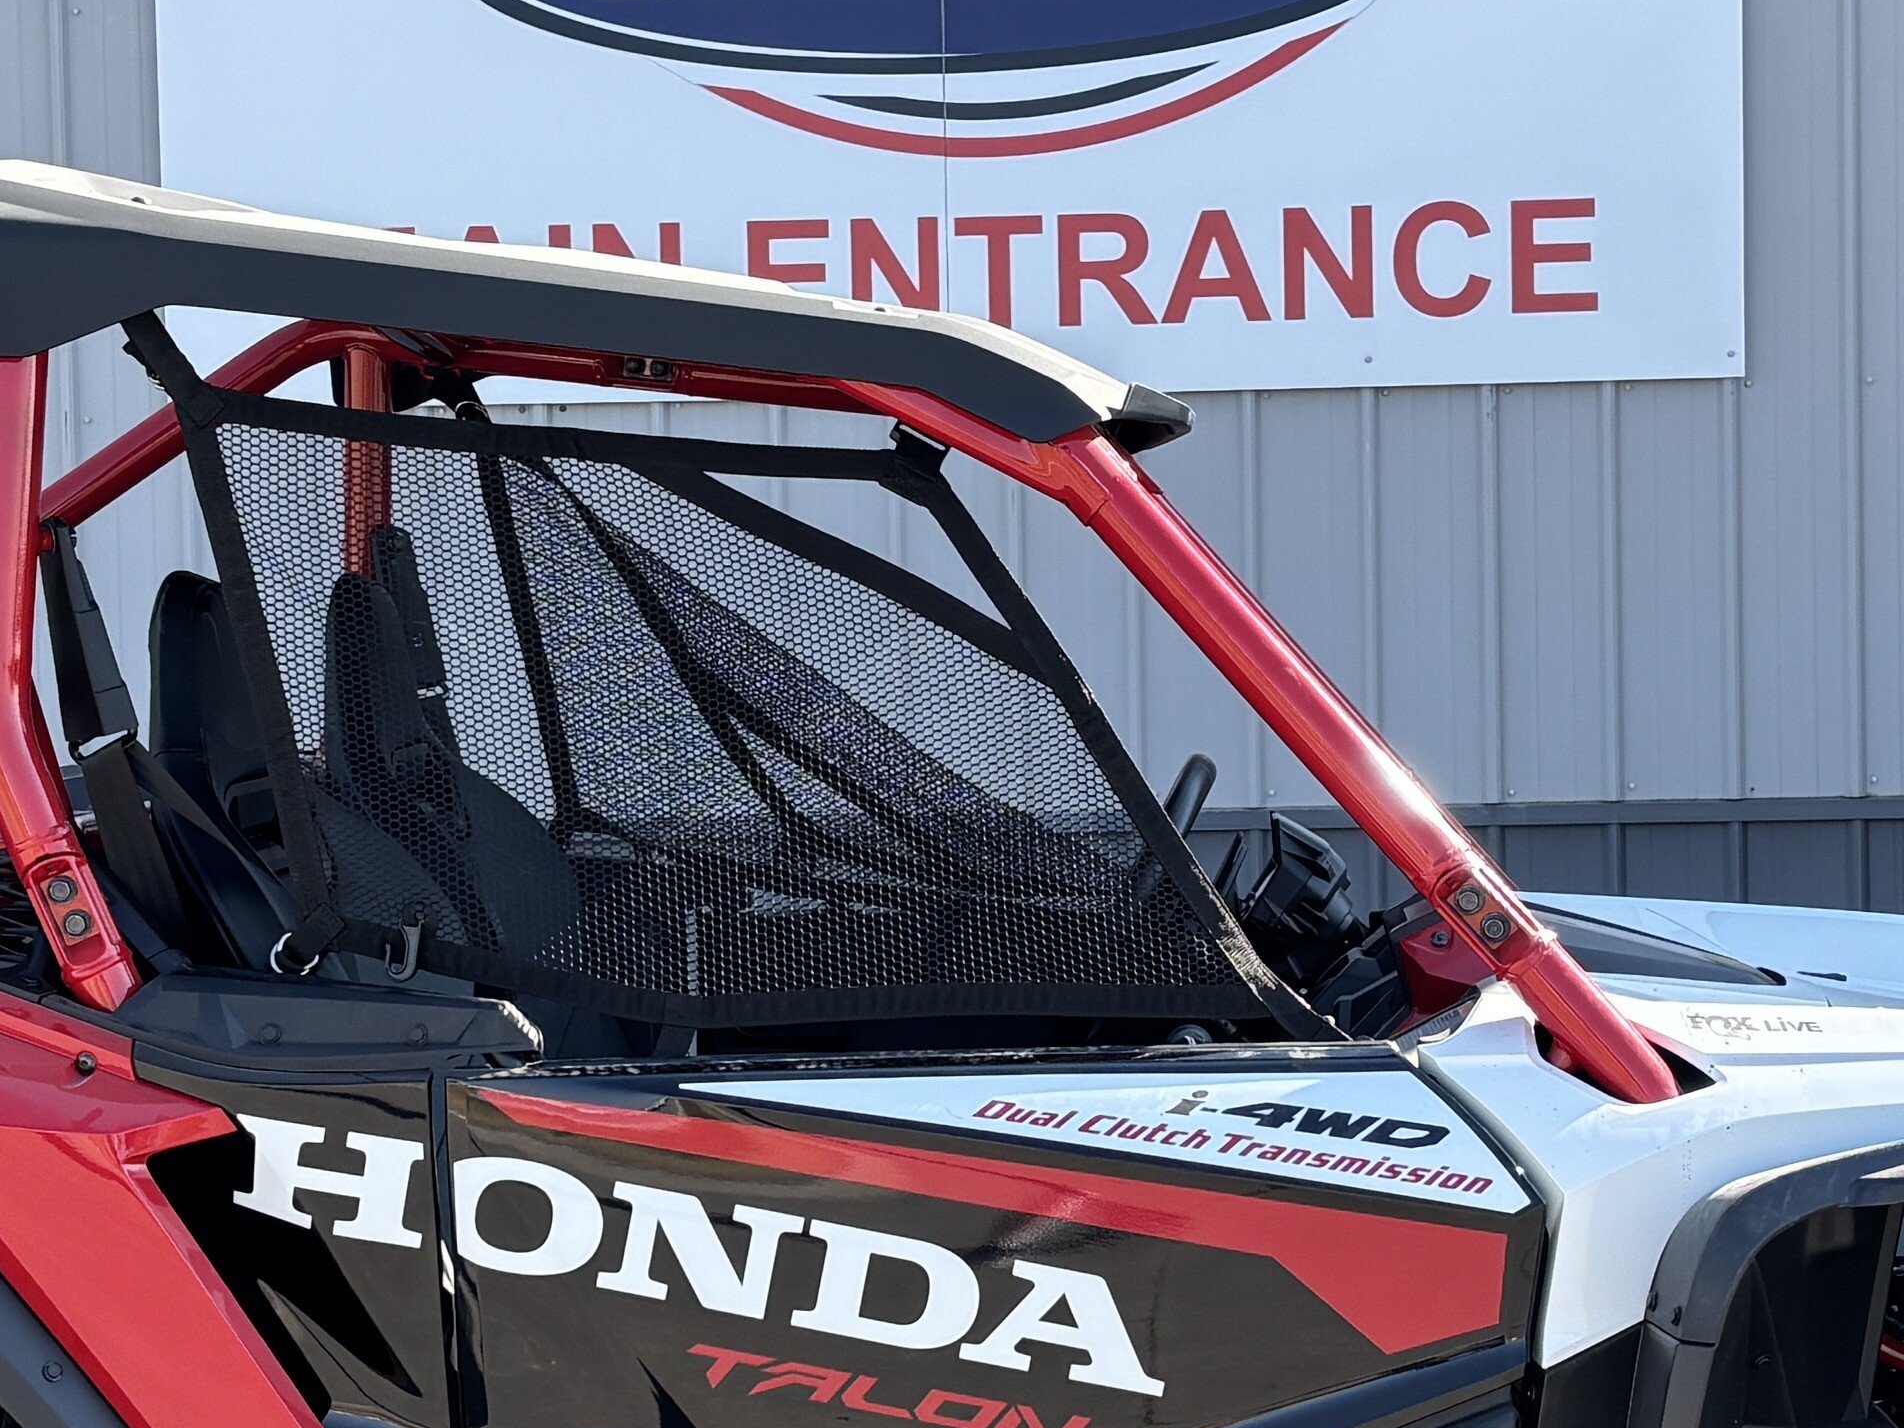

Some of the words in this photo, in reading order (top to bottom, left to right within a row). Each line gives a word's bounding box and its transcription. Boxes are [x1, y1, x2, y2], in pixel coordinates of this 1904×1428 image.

[746, 197, 1600, 329] ENTRANCE
[1686, 1012, 1760, 1040] FOX
[972, 1099, 1079, 1130] Dual
[1077, 1113, 1212, 1151] Clutch
[1216, 1132, 1494, 1195] Transmission
[1164, 1089, 1451, 1149] i-4WD
[233, 1112, 1166, 1398] HONDA
